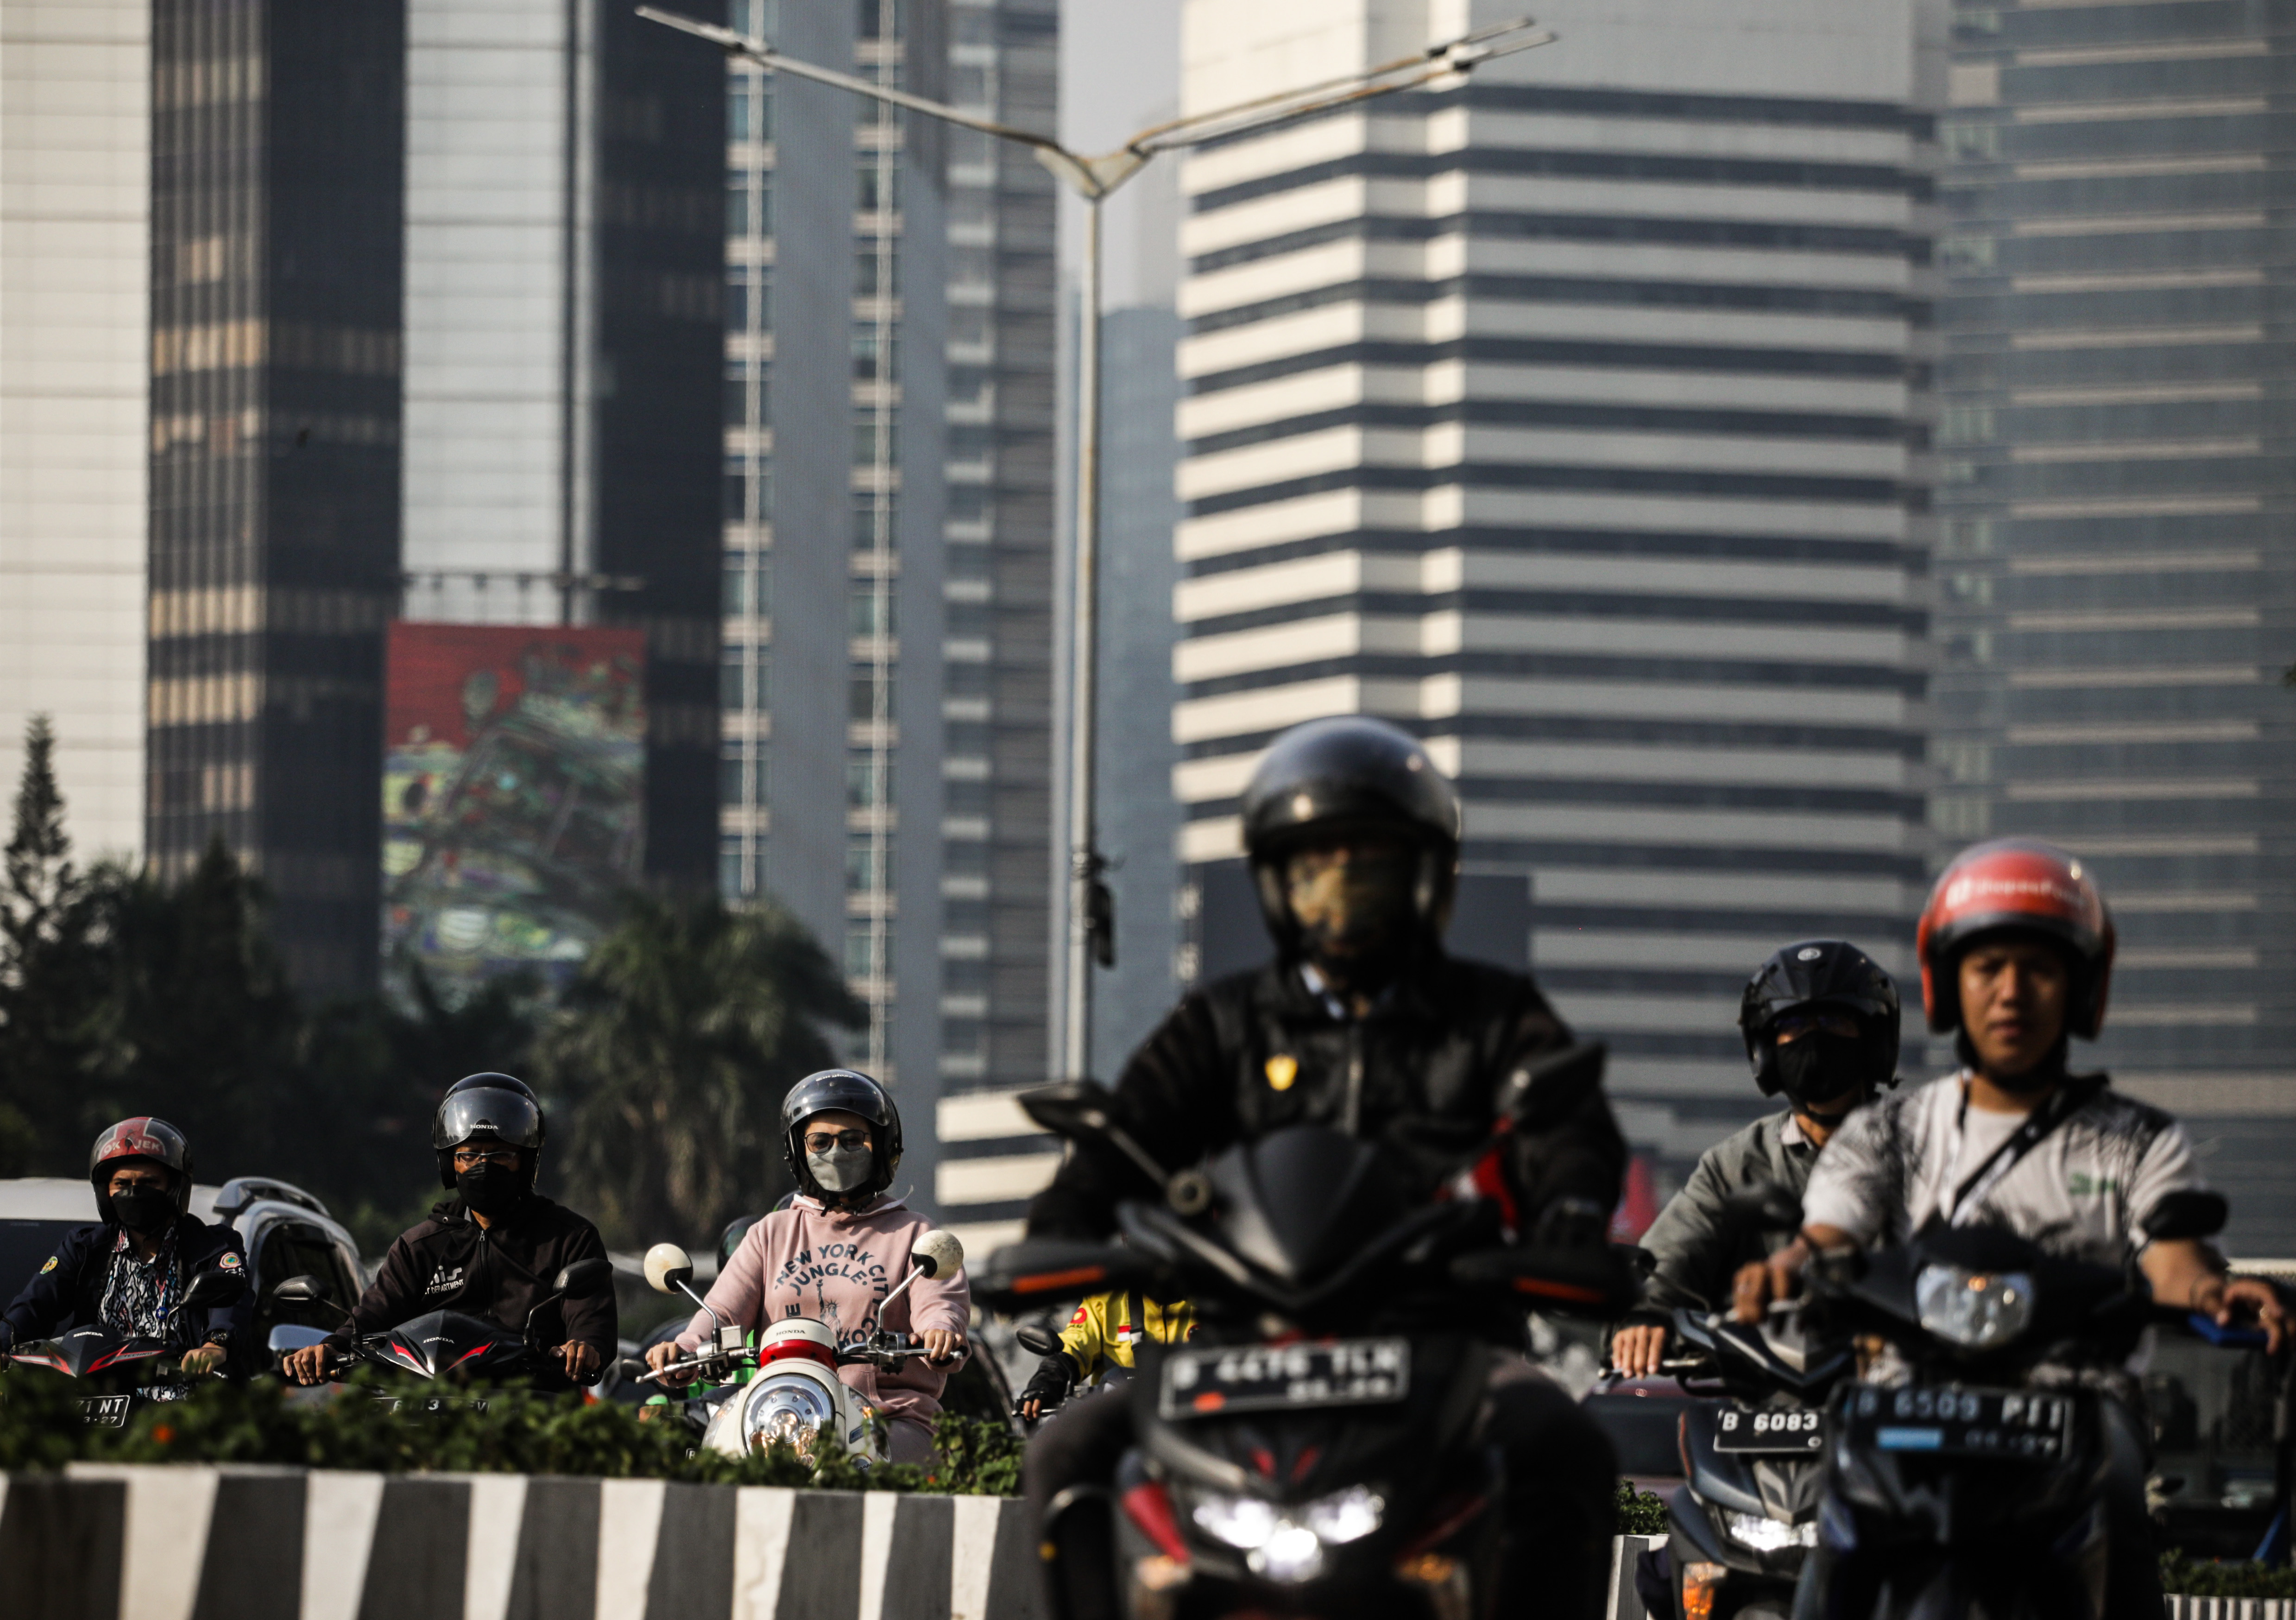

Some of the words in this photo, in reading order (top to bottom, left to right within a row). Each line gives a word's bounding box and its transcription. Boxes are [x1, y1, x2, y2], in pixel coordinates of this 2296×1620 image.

[104, 1141, 120, 1153] OK
[135, 1139, 160, 1151] JEK
[776, 1250, 812, 1285] NEW
[818, 1244, 874, 1266] YORK
[431, 1279, 463, 1294] DEPARTMENT
[789, 1263, 867, 1297] JUNGLE
[99, 1399, 123, 1413] NT
[1722, 1412, 1738, 1431] B
[1754, 1413, 1818, 1432] 6083
